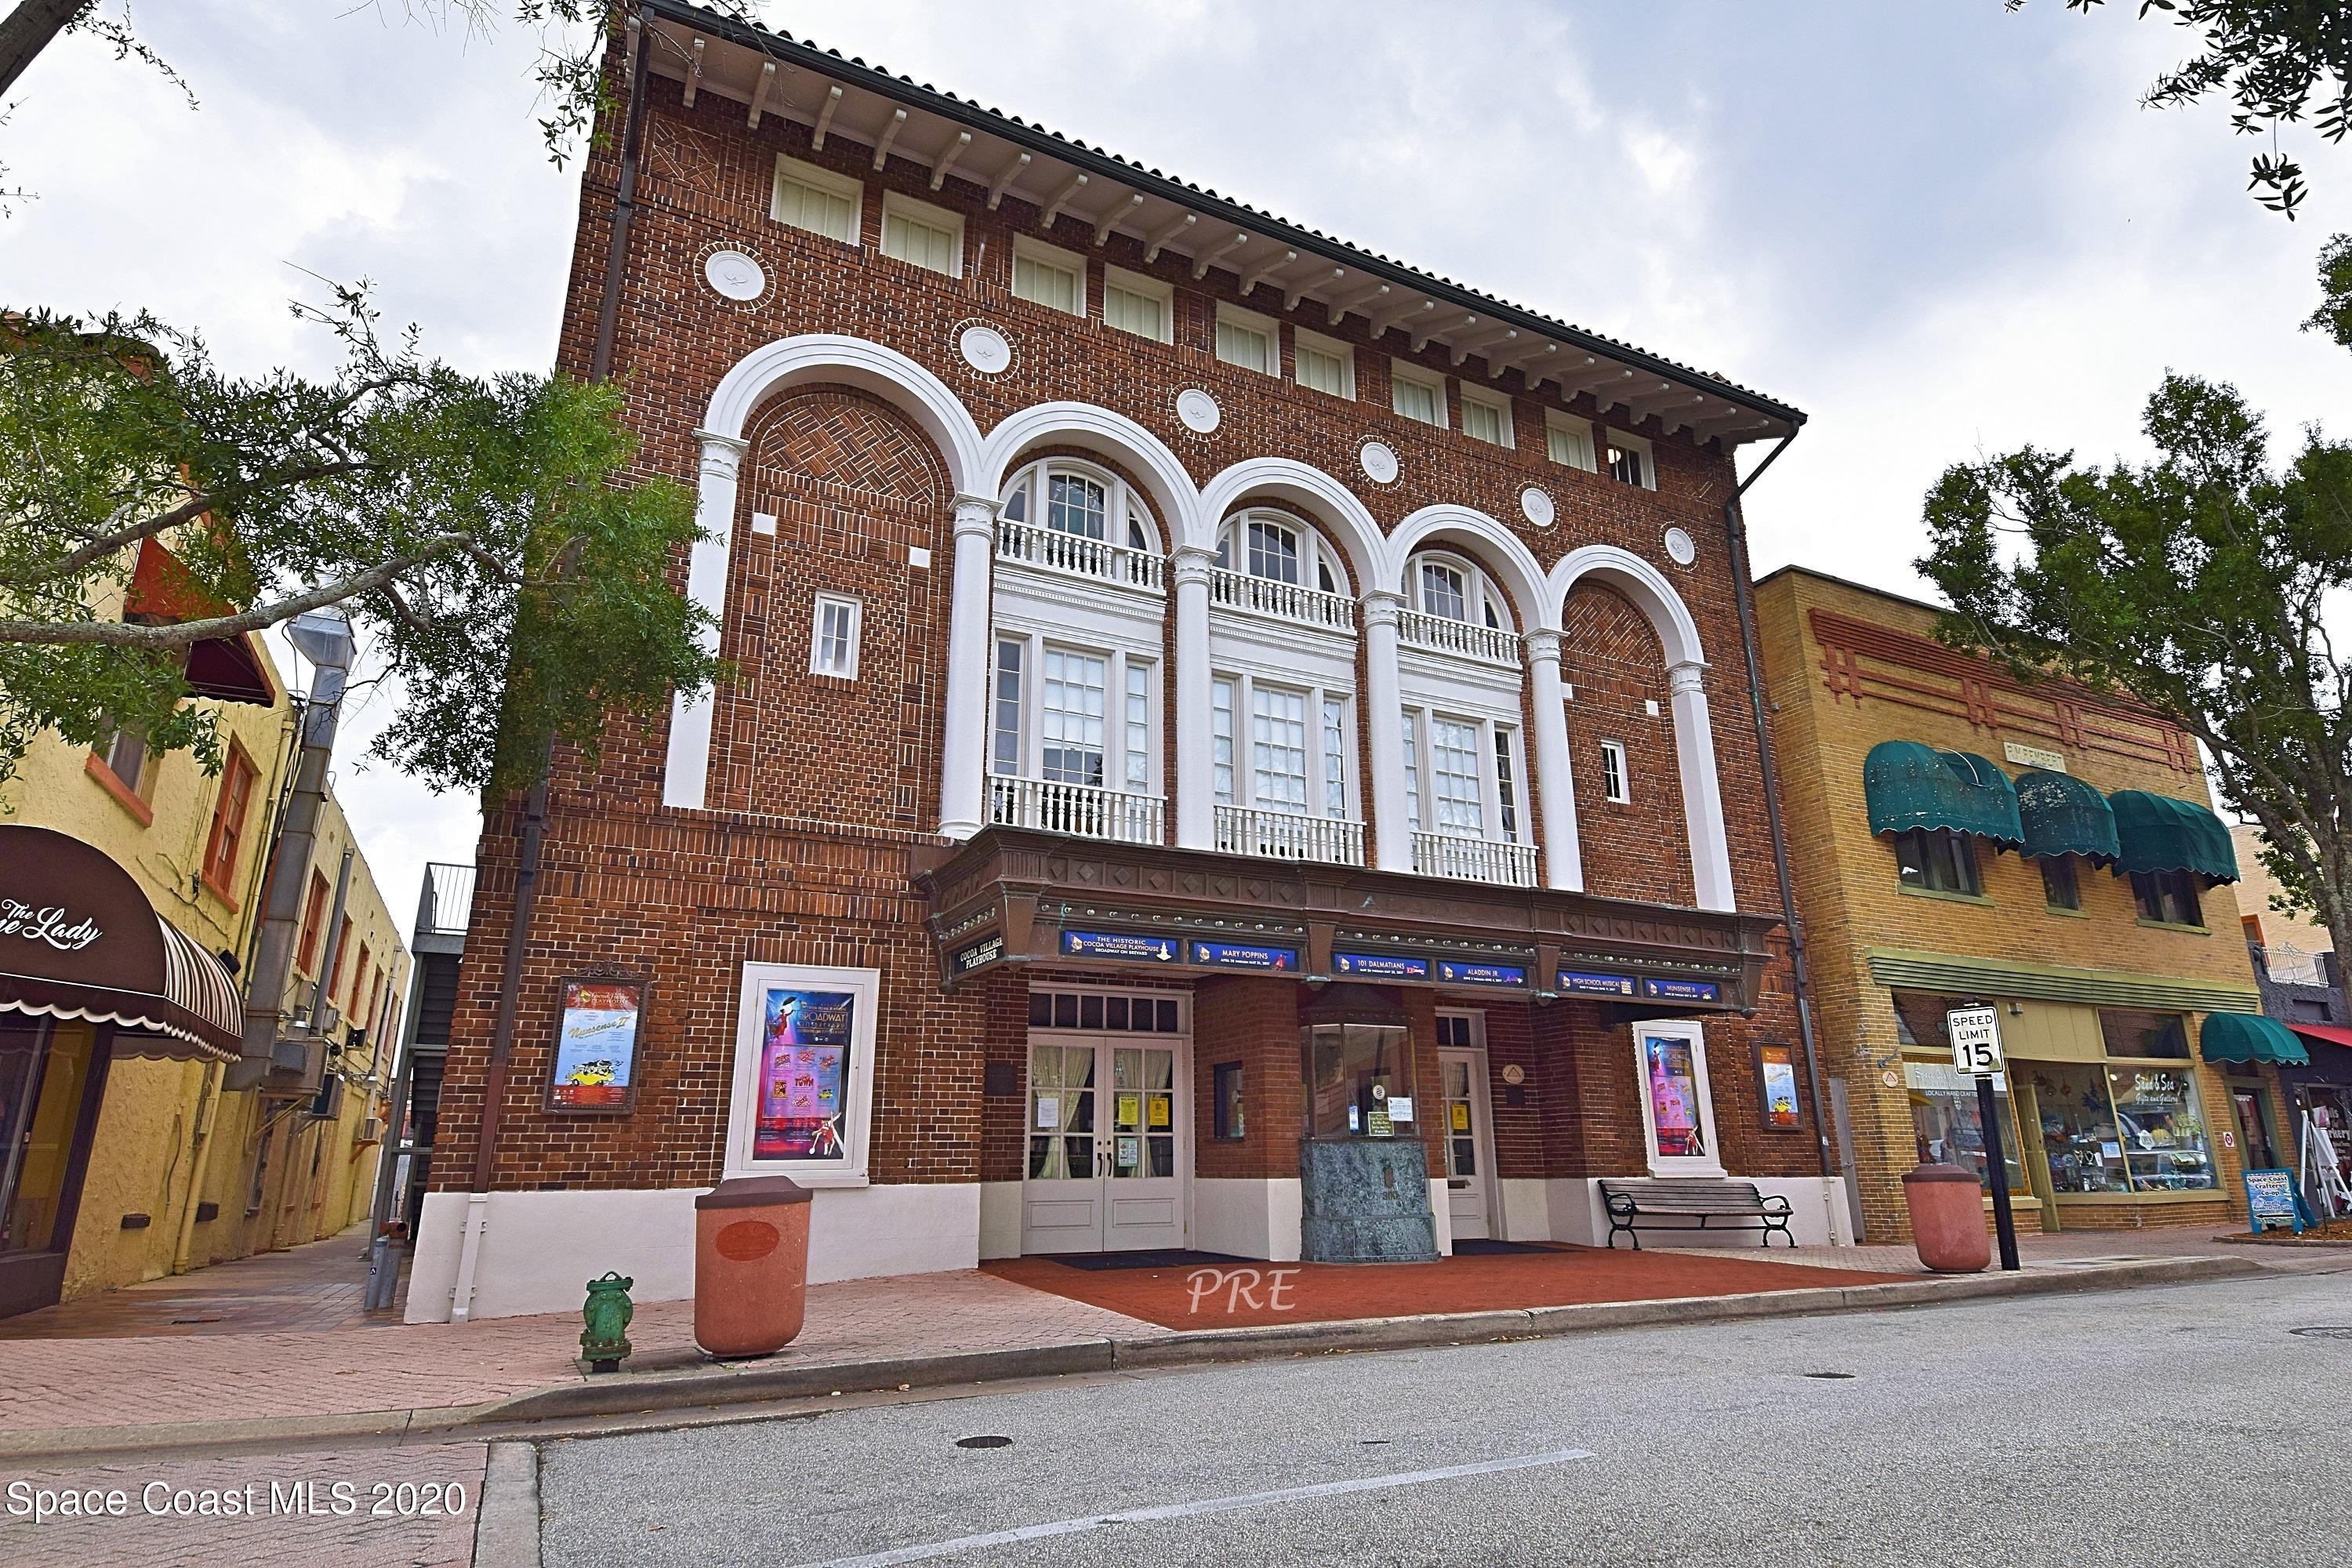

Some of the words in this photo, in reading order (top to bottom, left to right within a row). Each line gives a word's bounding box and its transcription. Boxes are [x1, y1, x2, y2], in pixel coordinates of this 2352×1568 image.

[2, 898, 35, 920] The
[22, 907, 103, 950] Lady
[960, 948, 978, 961] COCOA
[980, 937, 1003, 953] VILLAGE
[1242, 951, 1269, 960] POPPINS
[965, 949, 997, 969] PLAYHOUSE
[1368, 960, 1405, 970] DALMATIANS
[1953, 1015, 1992, 1026] SPEED
[568, 1021, 617, 1039] Nunsense
[1959, 1029, 1989, 1040] LIMIT
[1963, 1044, 1993, 1066] 15
[2135, 1073, 2154, 1091] Sand
[2154, 1073, 2160, 1091] &
[2161, 1073, 2175, 1091] Sea
[2136, 1093, 2149, 1105] Gifts
[2159, 1093, 2178, 1105] Gallery
